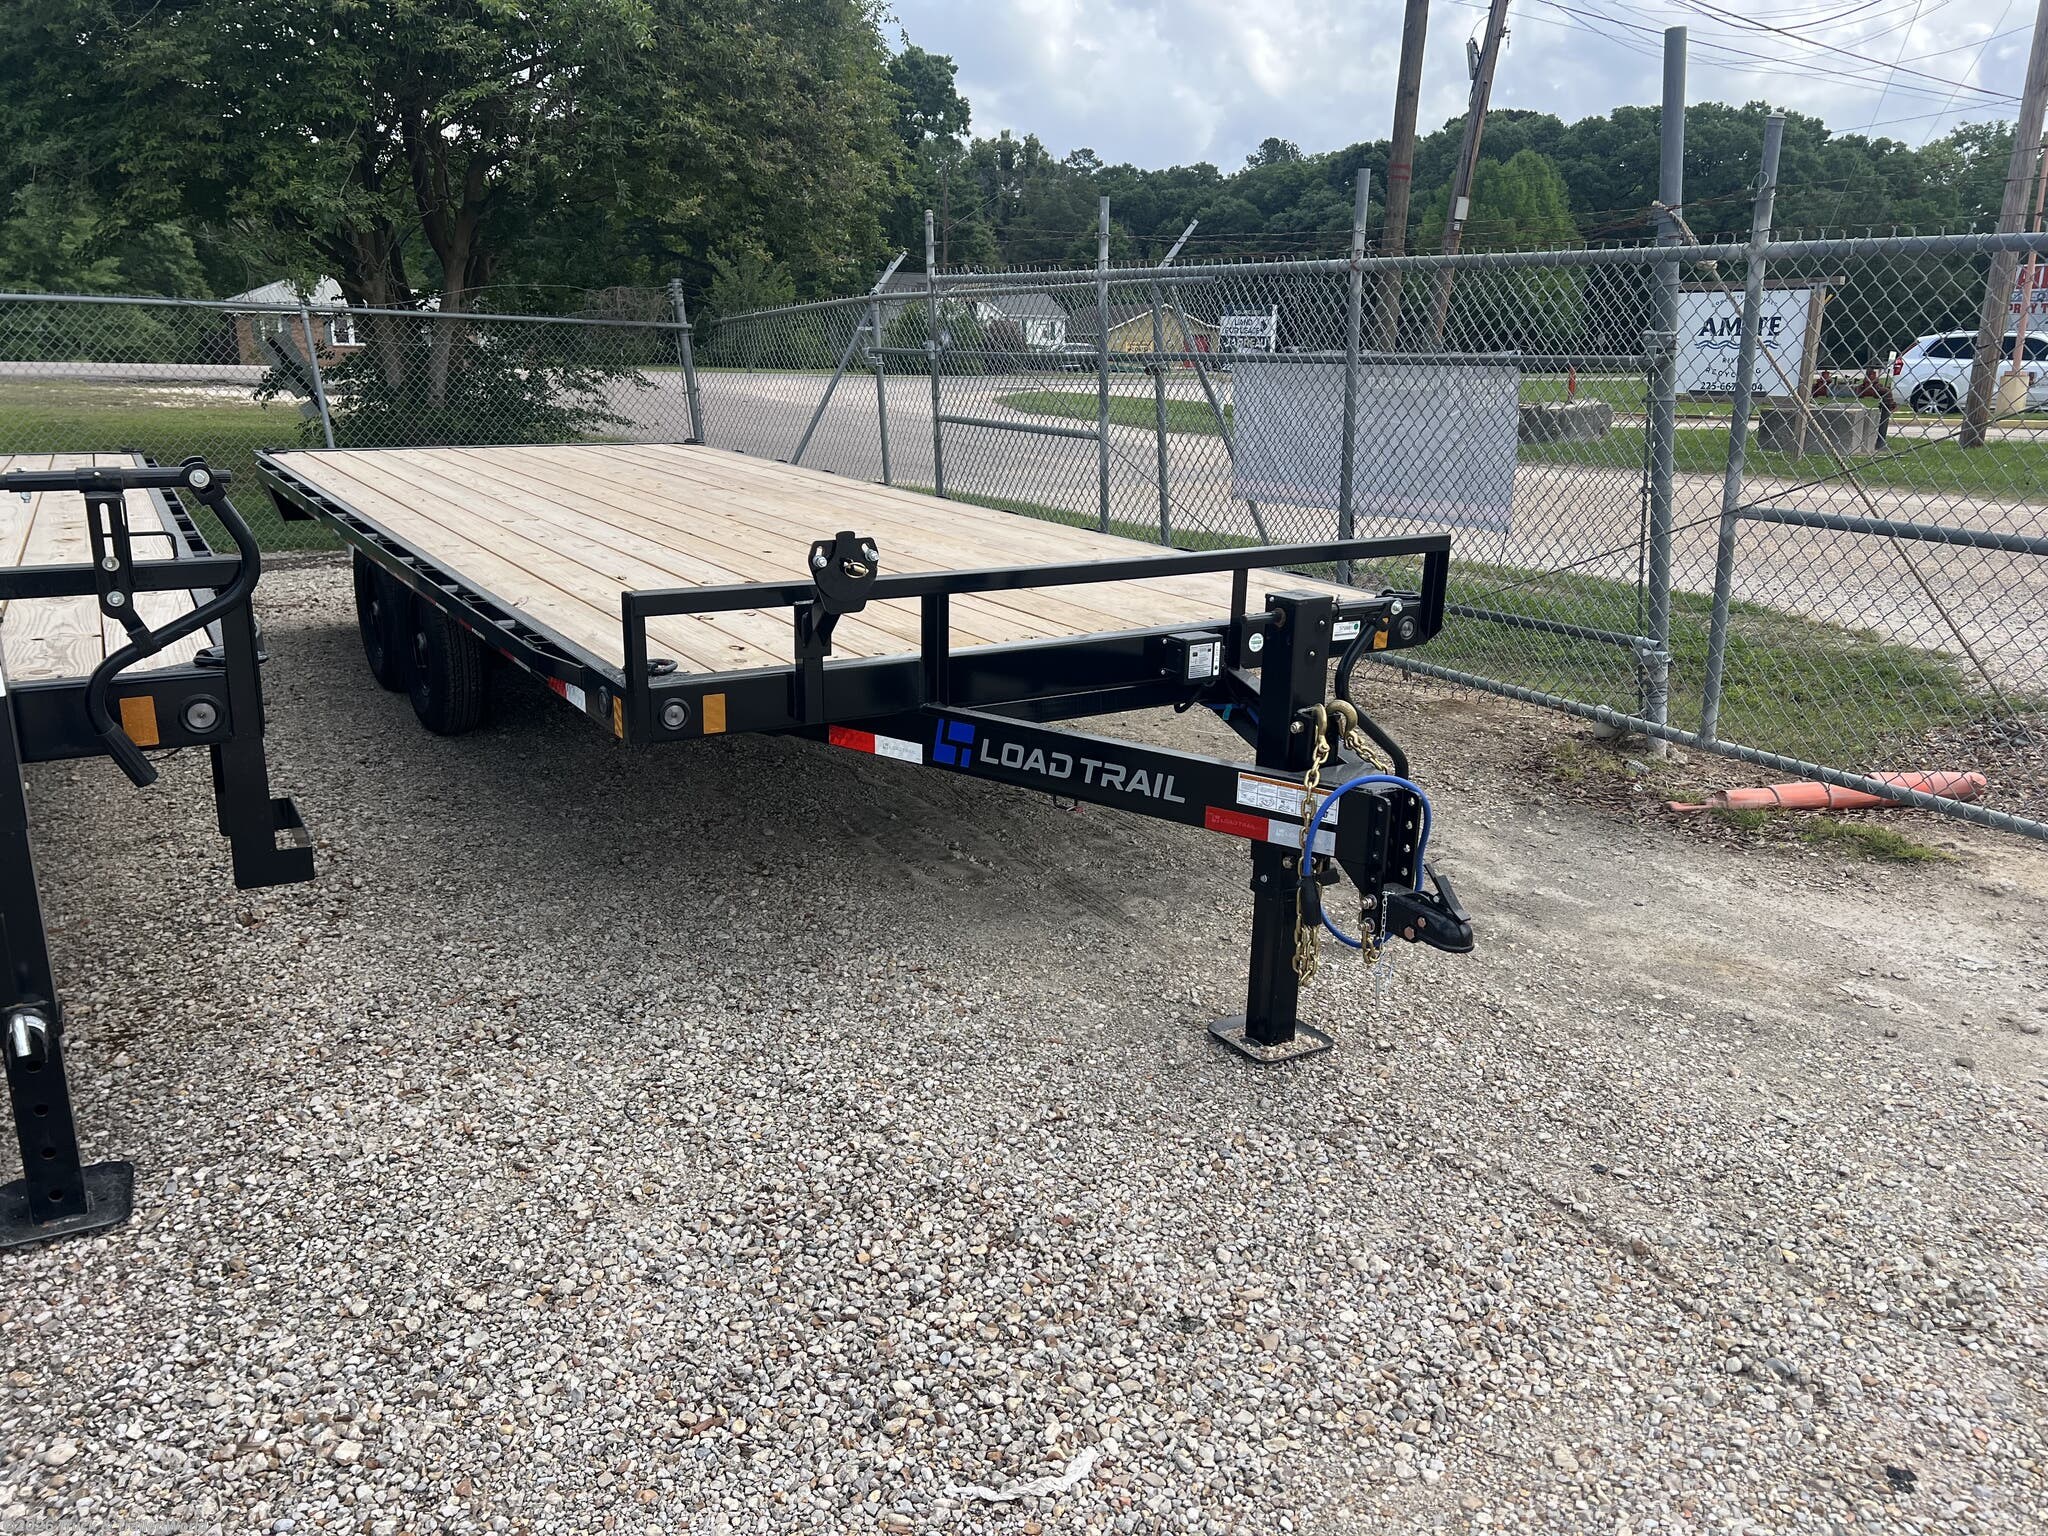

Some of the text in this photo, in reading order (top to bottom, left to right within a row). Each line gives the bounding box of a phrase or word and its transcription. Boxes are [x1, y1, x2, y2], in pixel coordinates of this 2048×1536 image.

[1698, 316, 1781, 337] AMTE
[1705, 367, 1761, 378] RECYCG
[980, 738, 1186, 804] LOAD TRAIL
